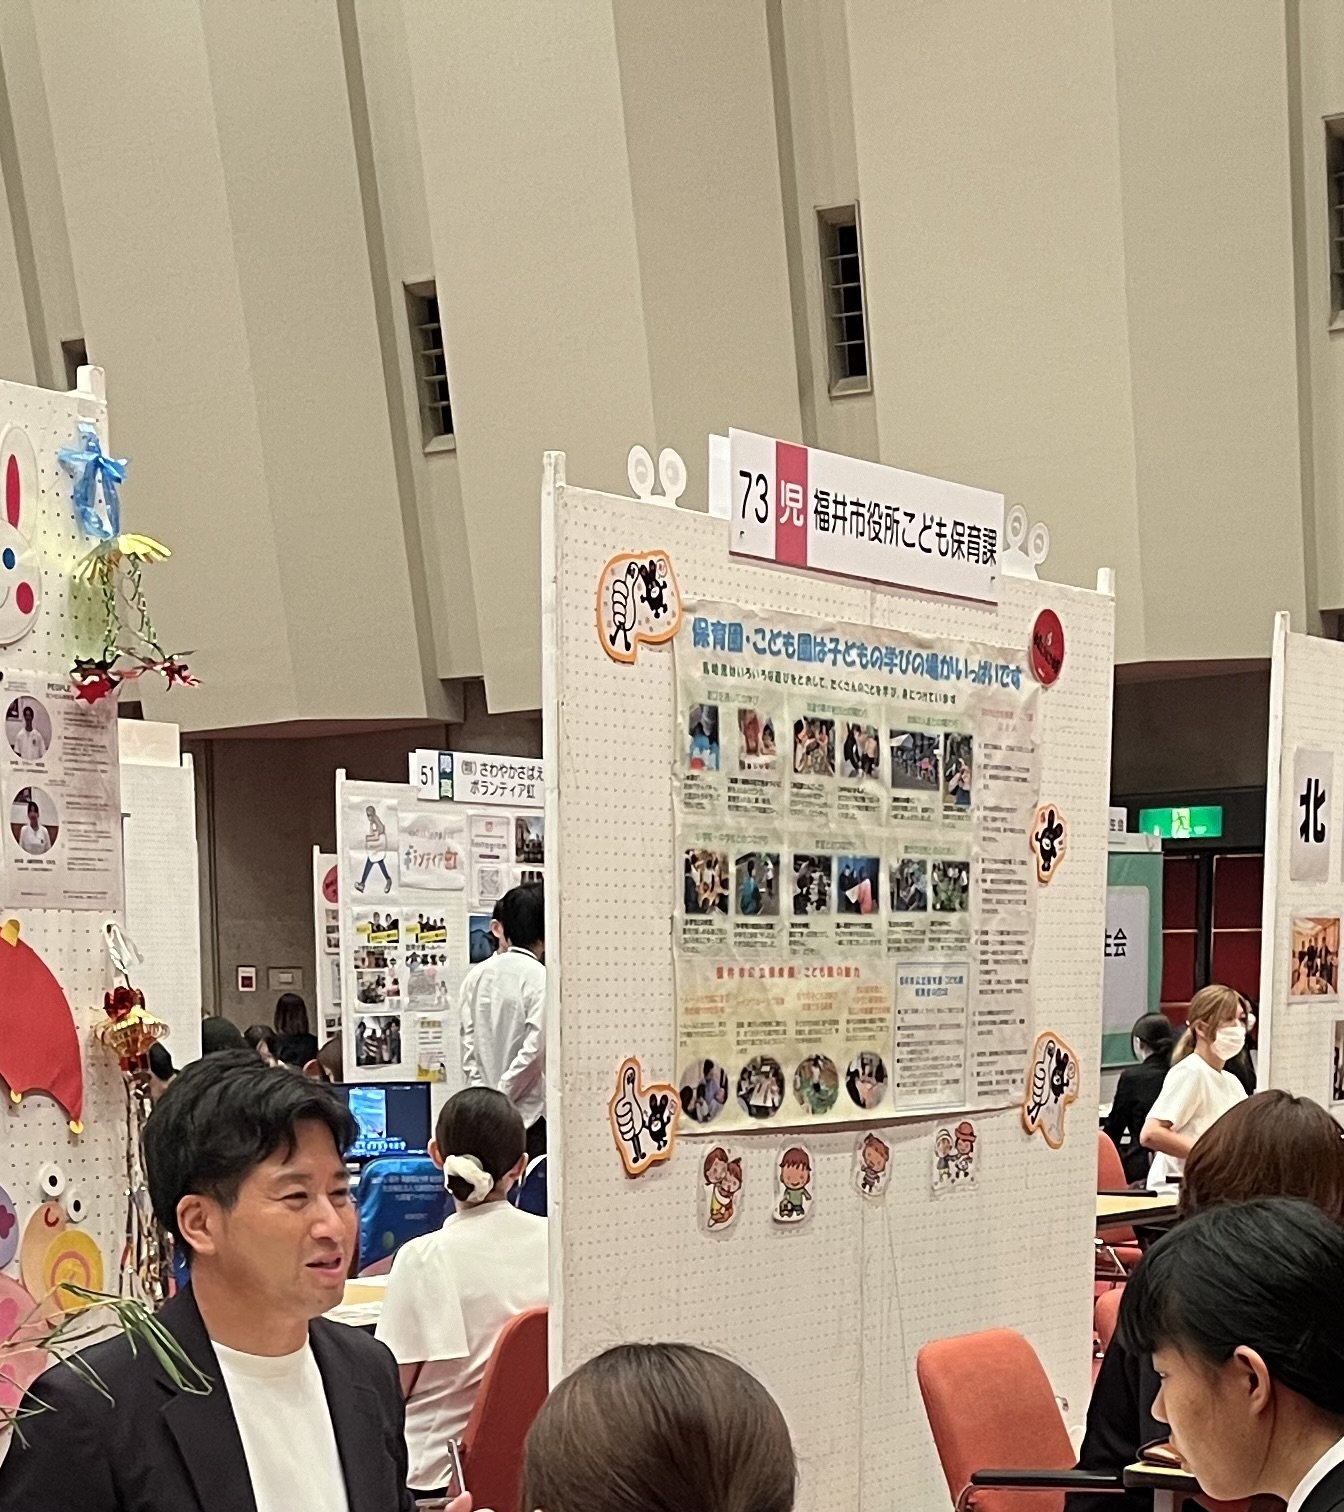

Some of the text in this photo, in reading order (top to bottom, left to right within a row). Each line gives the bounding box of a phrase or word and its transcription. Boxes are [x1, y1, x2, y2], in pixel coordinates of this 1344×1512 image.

[738, 470, 998, 566] 73 児 福井市役所こども保育課
[420, 765, 434, 785] 51
[480, 763, 544, 781] さわやかさばえ
[470, 781, 535, 798] ボランティア虹
